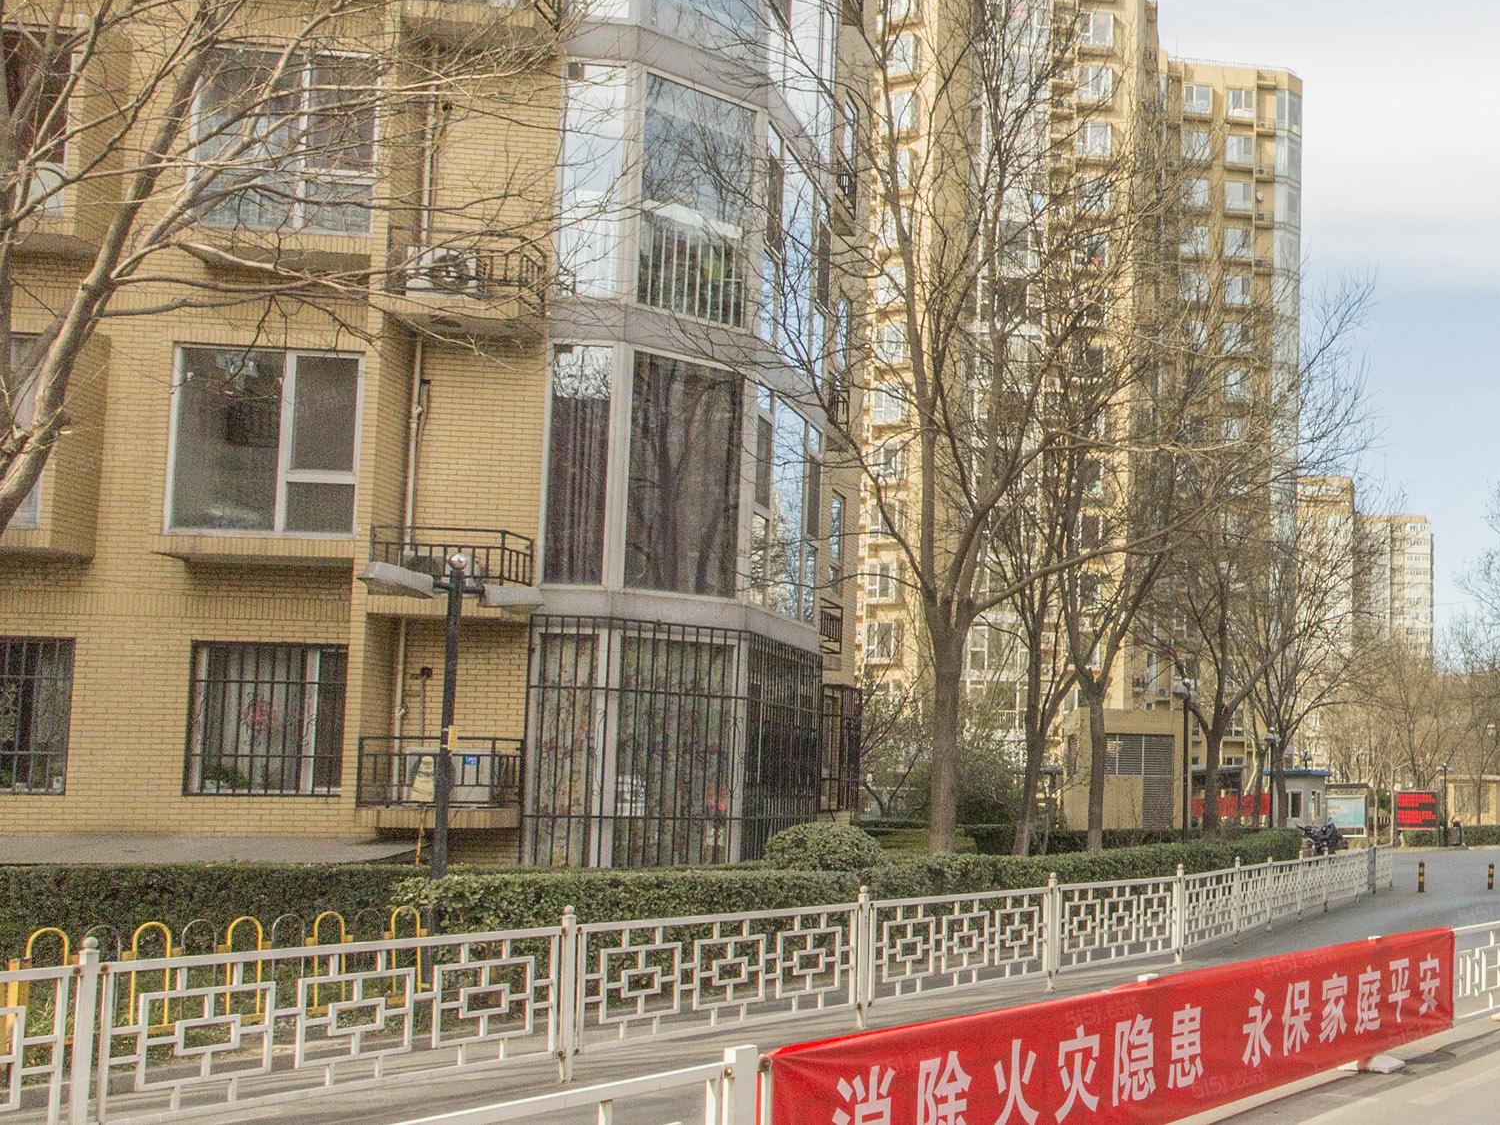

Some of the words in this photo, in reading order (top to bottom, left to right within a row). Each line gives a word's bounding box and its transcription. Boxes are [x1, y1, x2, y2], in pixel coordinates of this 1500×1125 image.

[832, 1003, 1204, 1125] 消除火灾隐患
[1242, 953, 1441, 1068] 永保家庭平安
